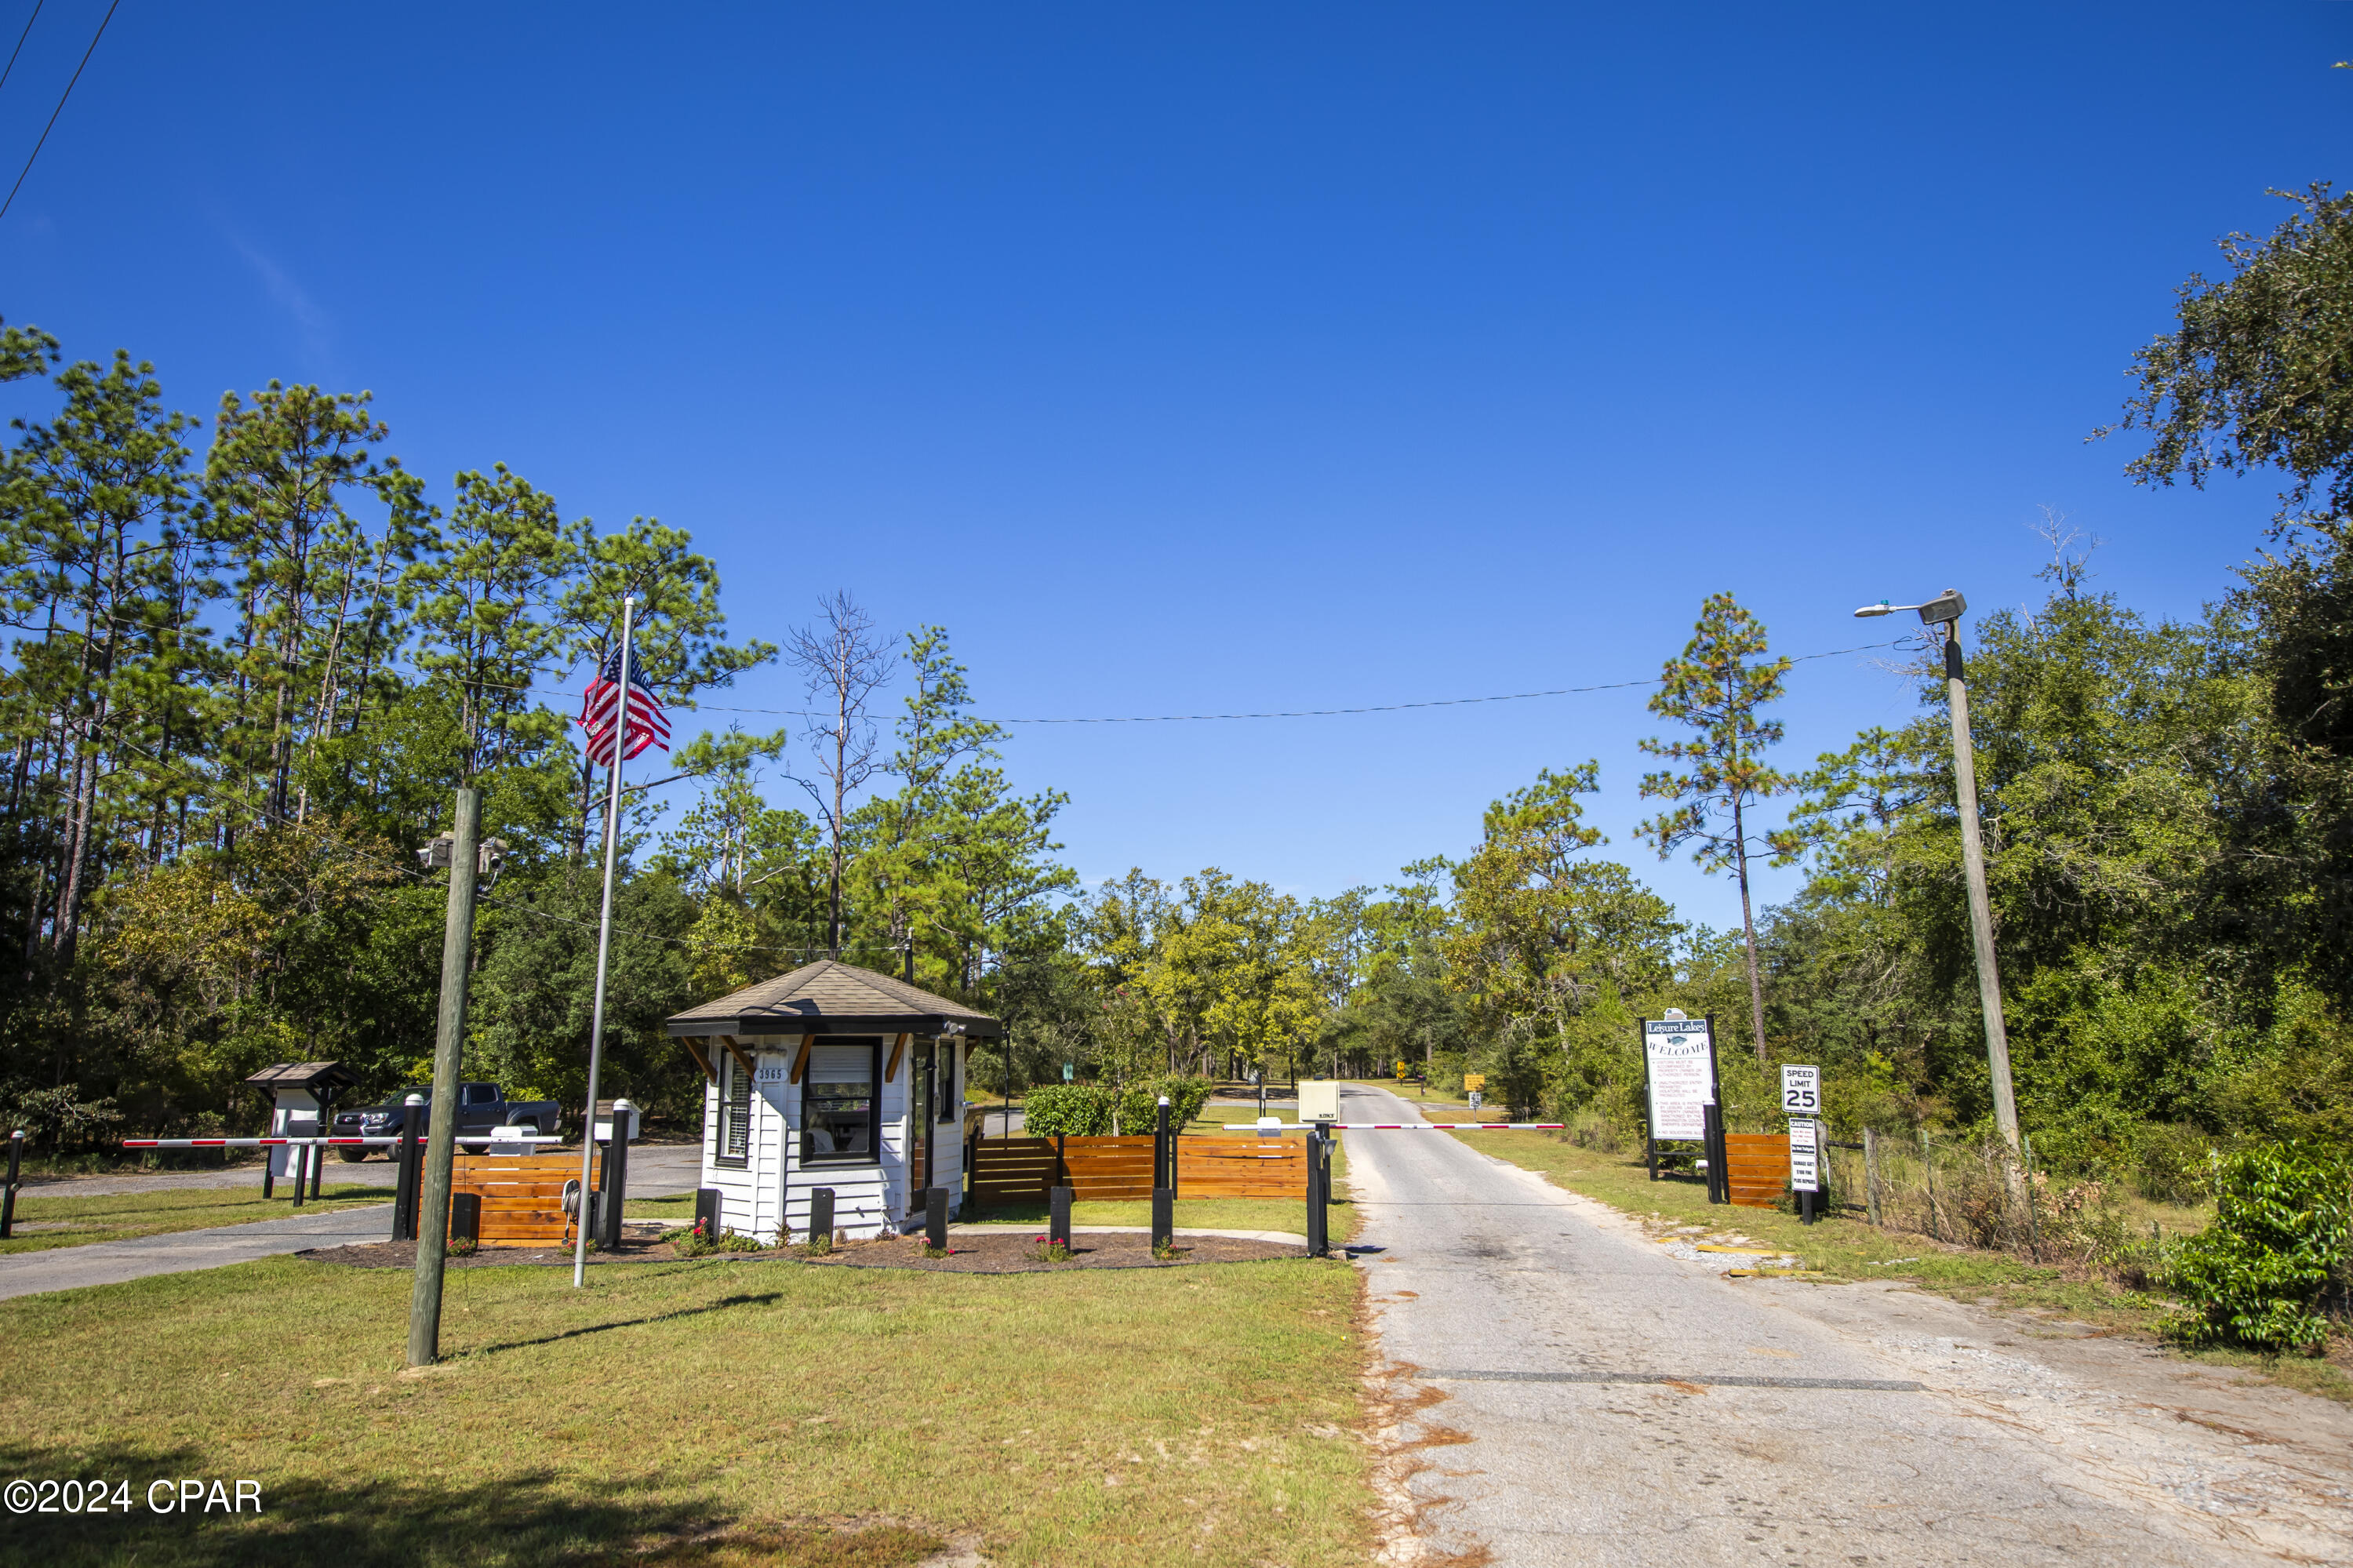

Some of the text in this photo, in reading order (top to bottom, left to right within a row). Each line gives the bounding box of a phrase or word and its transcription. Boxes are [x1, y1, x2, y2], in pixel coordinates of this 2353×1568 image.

[1648, 1021, 1704, 1034] Leisure Lakes
[1649, 1040, 1708, 1056] WELCOME
[759, 1069, 781, 1079] 3965
[1787, 1090, 1815, 1108] 25
